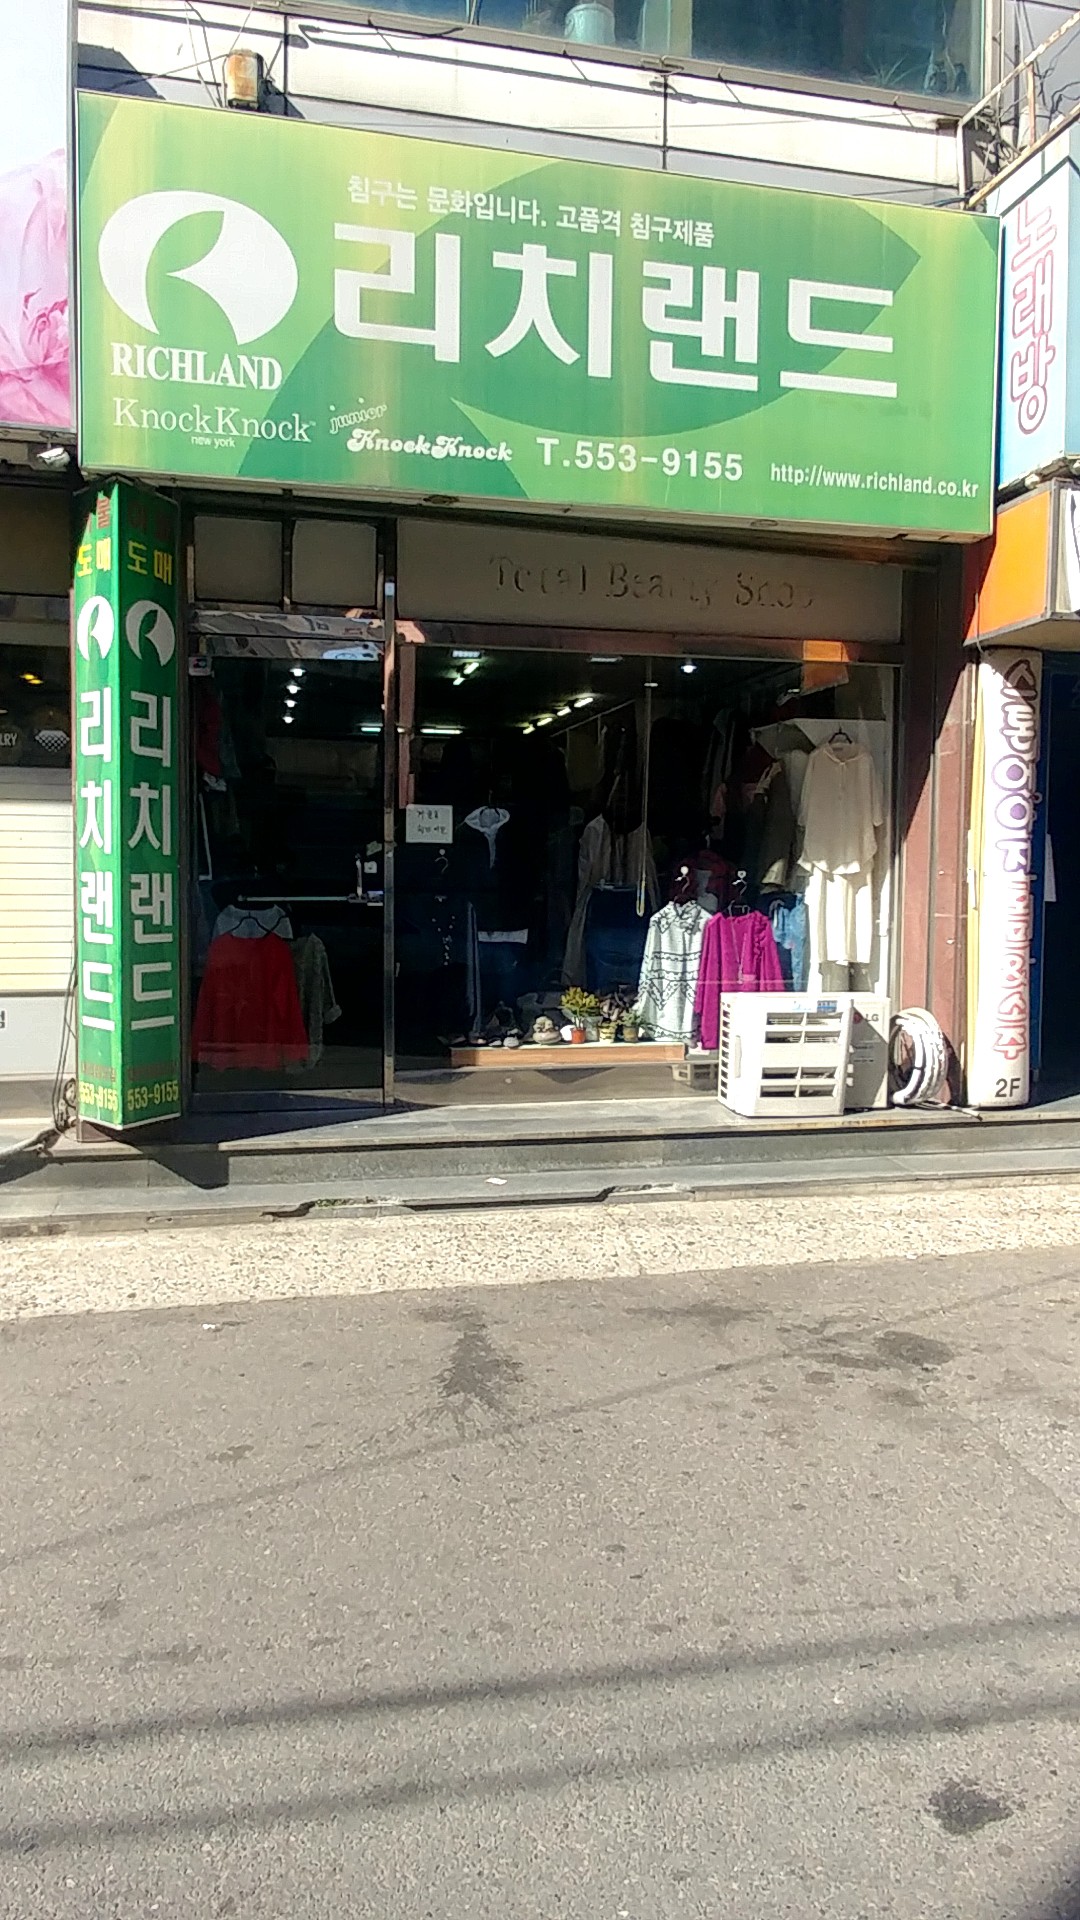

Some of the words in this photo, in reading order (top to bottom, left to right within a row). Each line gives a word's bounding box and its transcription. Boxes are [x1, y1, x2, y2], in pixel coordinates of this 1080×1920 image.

[347, 174, 417, 211] 침구는
[426, 186, 547, 227] 문화입니다.
[556, 203, 621, 237] 고품격
[630, 211, 715, 248] 침구제품
[333, 222, 898, 398] 리치랜드
[1010, 199, 1057, 435] 노래방
[110, 342, 283, 390] RICHLAND
[113, 397, 312, 443] KnockKnock
[329, 396, 388, 434] junior
[191, 434, 212, 446] new
[214, 437, 236, 449] york
[346, 428, 512, 461] KnockKnock
[536, 436, 744, 481] T.553-9155
[769, 462, 979, 498] http://www.richland.co.kr
[127, 540, 173, 585] 도매
[79, 686, 116, 1031] 리치랜드
[128, 690, 175, 1031] 리치랜드
[865, 1013, 880, 1022] LG
[79, 1081, 119, 1112] 553-9155
[127, 1080, 179, 1111] 553-9155
[995, 1078, 1021, 1098] 2F
